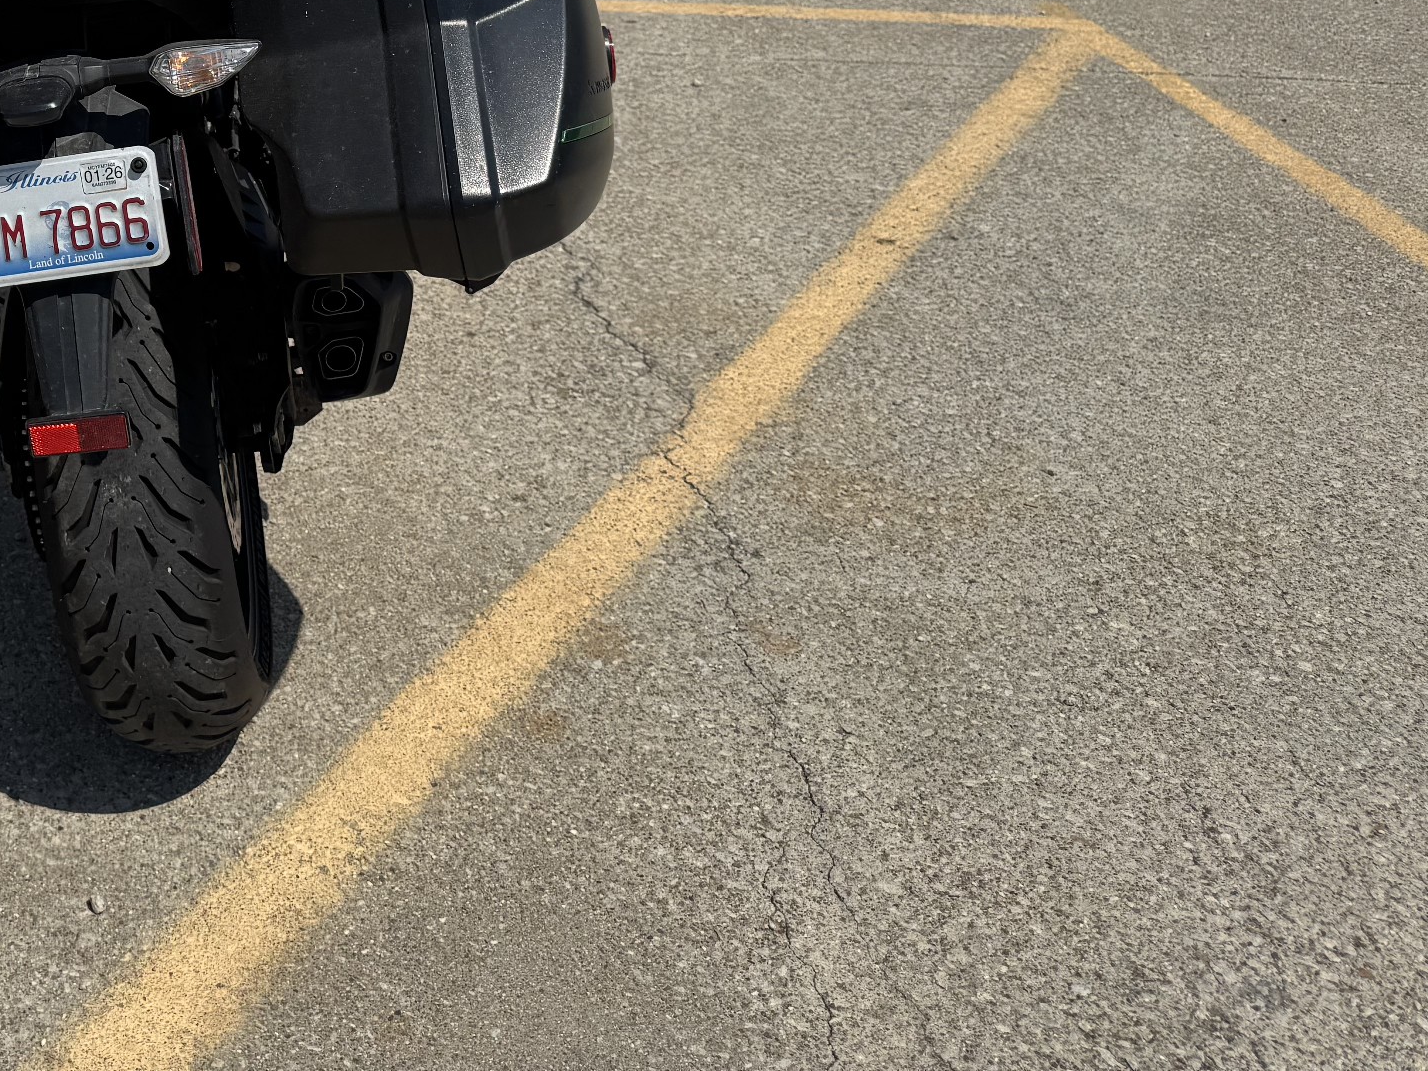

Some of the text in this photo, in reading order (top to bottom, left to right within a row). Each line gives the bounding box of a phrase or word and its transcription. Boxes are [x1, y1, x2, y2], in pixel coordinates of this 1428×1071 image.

[39, 197, 150, 255] 7866
[29, 250, 104, 270] Land of Lincoln
